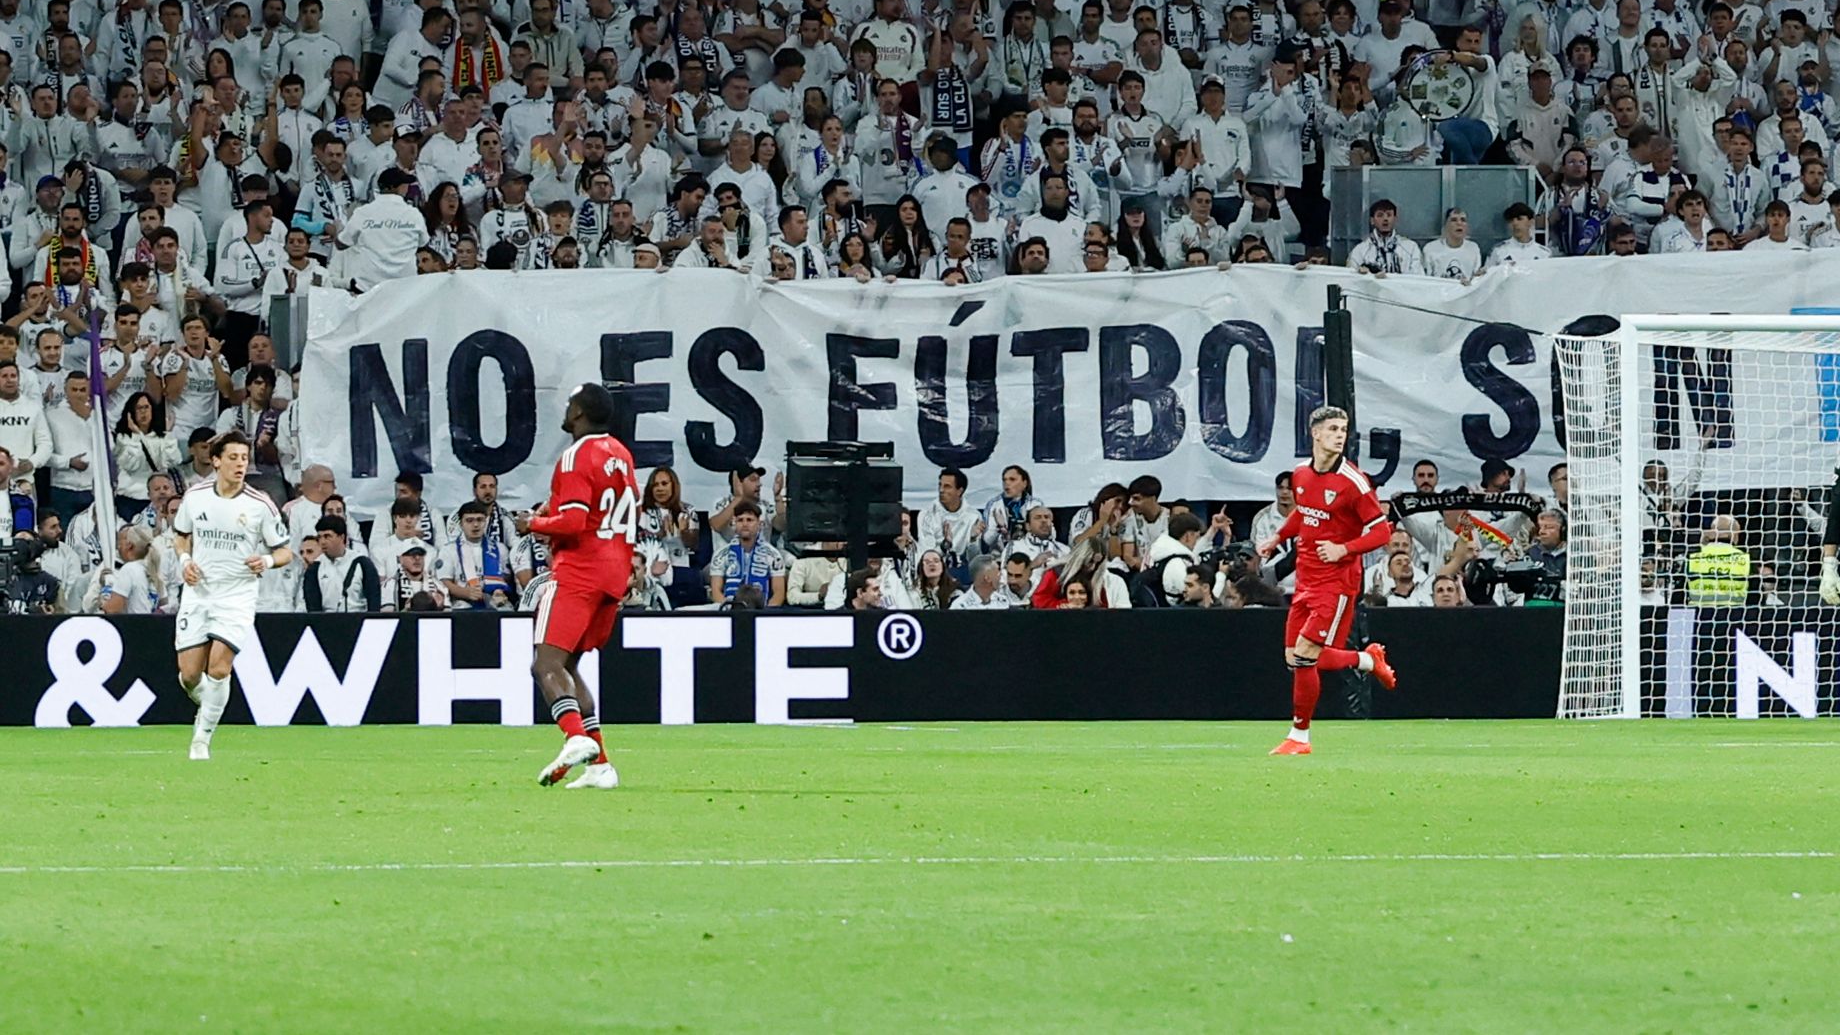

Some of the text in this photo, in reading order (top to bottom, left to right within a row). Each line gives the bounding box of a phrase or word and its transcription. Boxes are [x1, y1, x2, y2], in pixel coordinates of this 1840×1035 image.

[938, 92, 950, 119] SUR
[955, 108, 967, 125] LA
[349, 329, 537, 478] NO
[600, 326, 765, 472] ES
[197, 528, 246, 540] Emirates
[597, 486, 637, 544] 24
[35, 616, 157, 728] &
